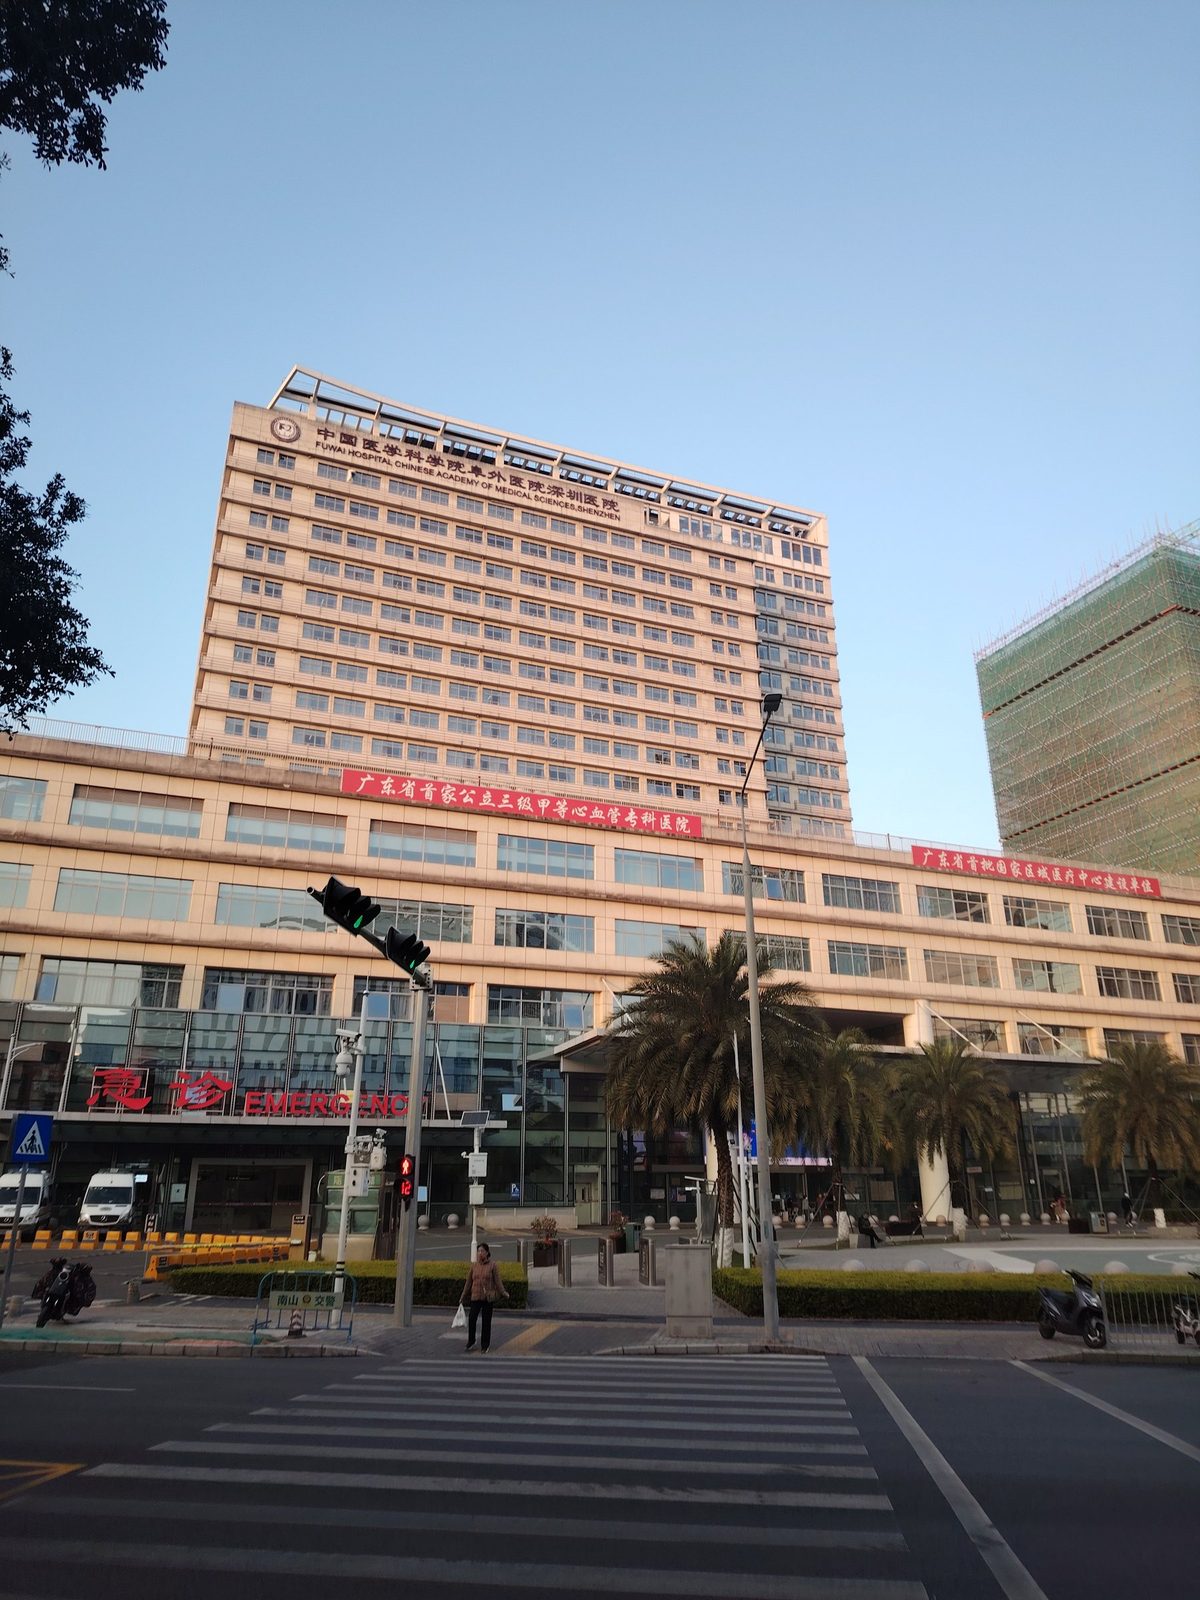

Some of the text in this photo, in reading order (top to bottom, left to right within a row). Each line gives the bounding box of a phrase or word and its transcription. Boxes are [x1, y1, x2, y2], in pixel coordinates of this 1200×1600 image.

[315, 441, 346, 454] FUWAI
[348, 449, 393, 466] HOSPITAL
[395, 460, 435, 475] CHINESE
[436, 470, 480, 488] ACADEMY
[481, 481, 494, 493] OF
[495, 485, 533, 501] MEDICAL
[317, 427, 620, 513] 中国医学科学院阜外医院深圳医院
[356, 773, 691, 834] 广东省首家公立三级甲等心血管专科医院
[922, 848, 1154, 894] 广东省首批国家区域医疗中心建设单位
[86, 1068, 233, 1110] 急诊
[245, 1091, 428, 1117] EMERGENC
[401, 1181, 411, 1195] 12
